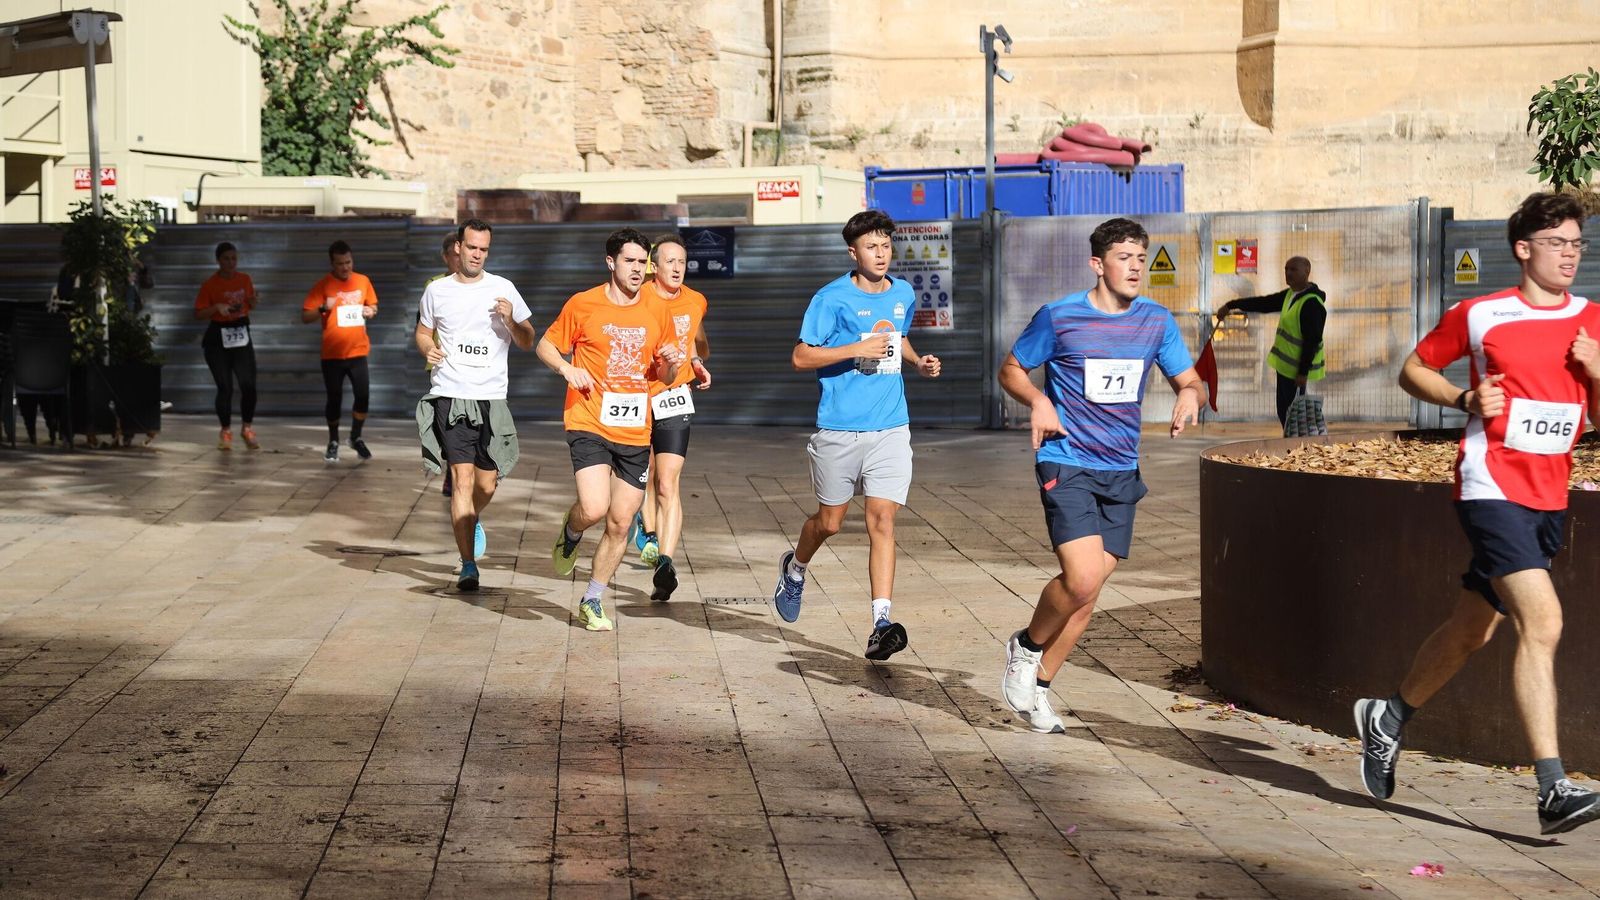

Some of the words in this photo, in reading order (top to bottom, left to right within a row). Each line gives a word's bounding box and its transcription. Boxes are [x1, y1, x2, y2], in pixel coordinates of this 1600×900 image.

[75, 169, 116, 181] RESA
[758, 181, 799, 193] REMSA
[923, 233, 949, 241] OBRAS
[226, 333, 245, 342] 773
[457, 343, 489, 356] 1063
[1102, 375, 1125, 390] 71
[659, 395, 686, 409] 460
[609, 405, 640, 417] 371
[1521, 418, 1574, 437] 1046
